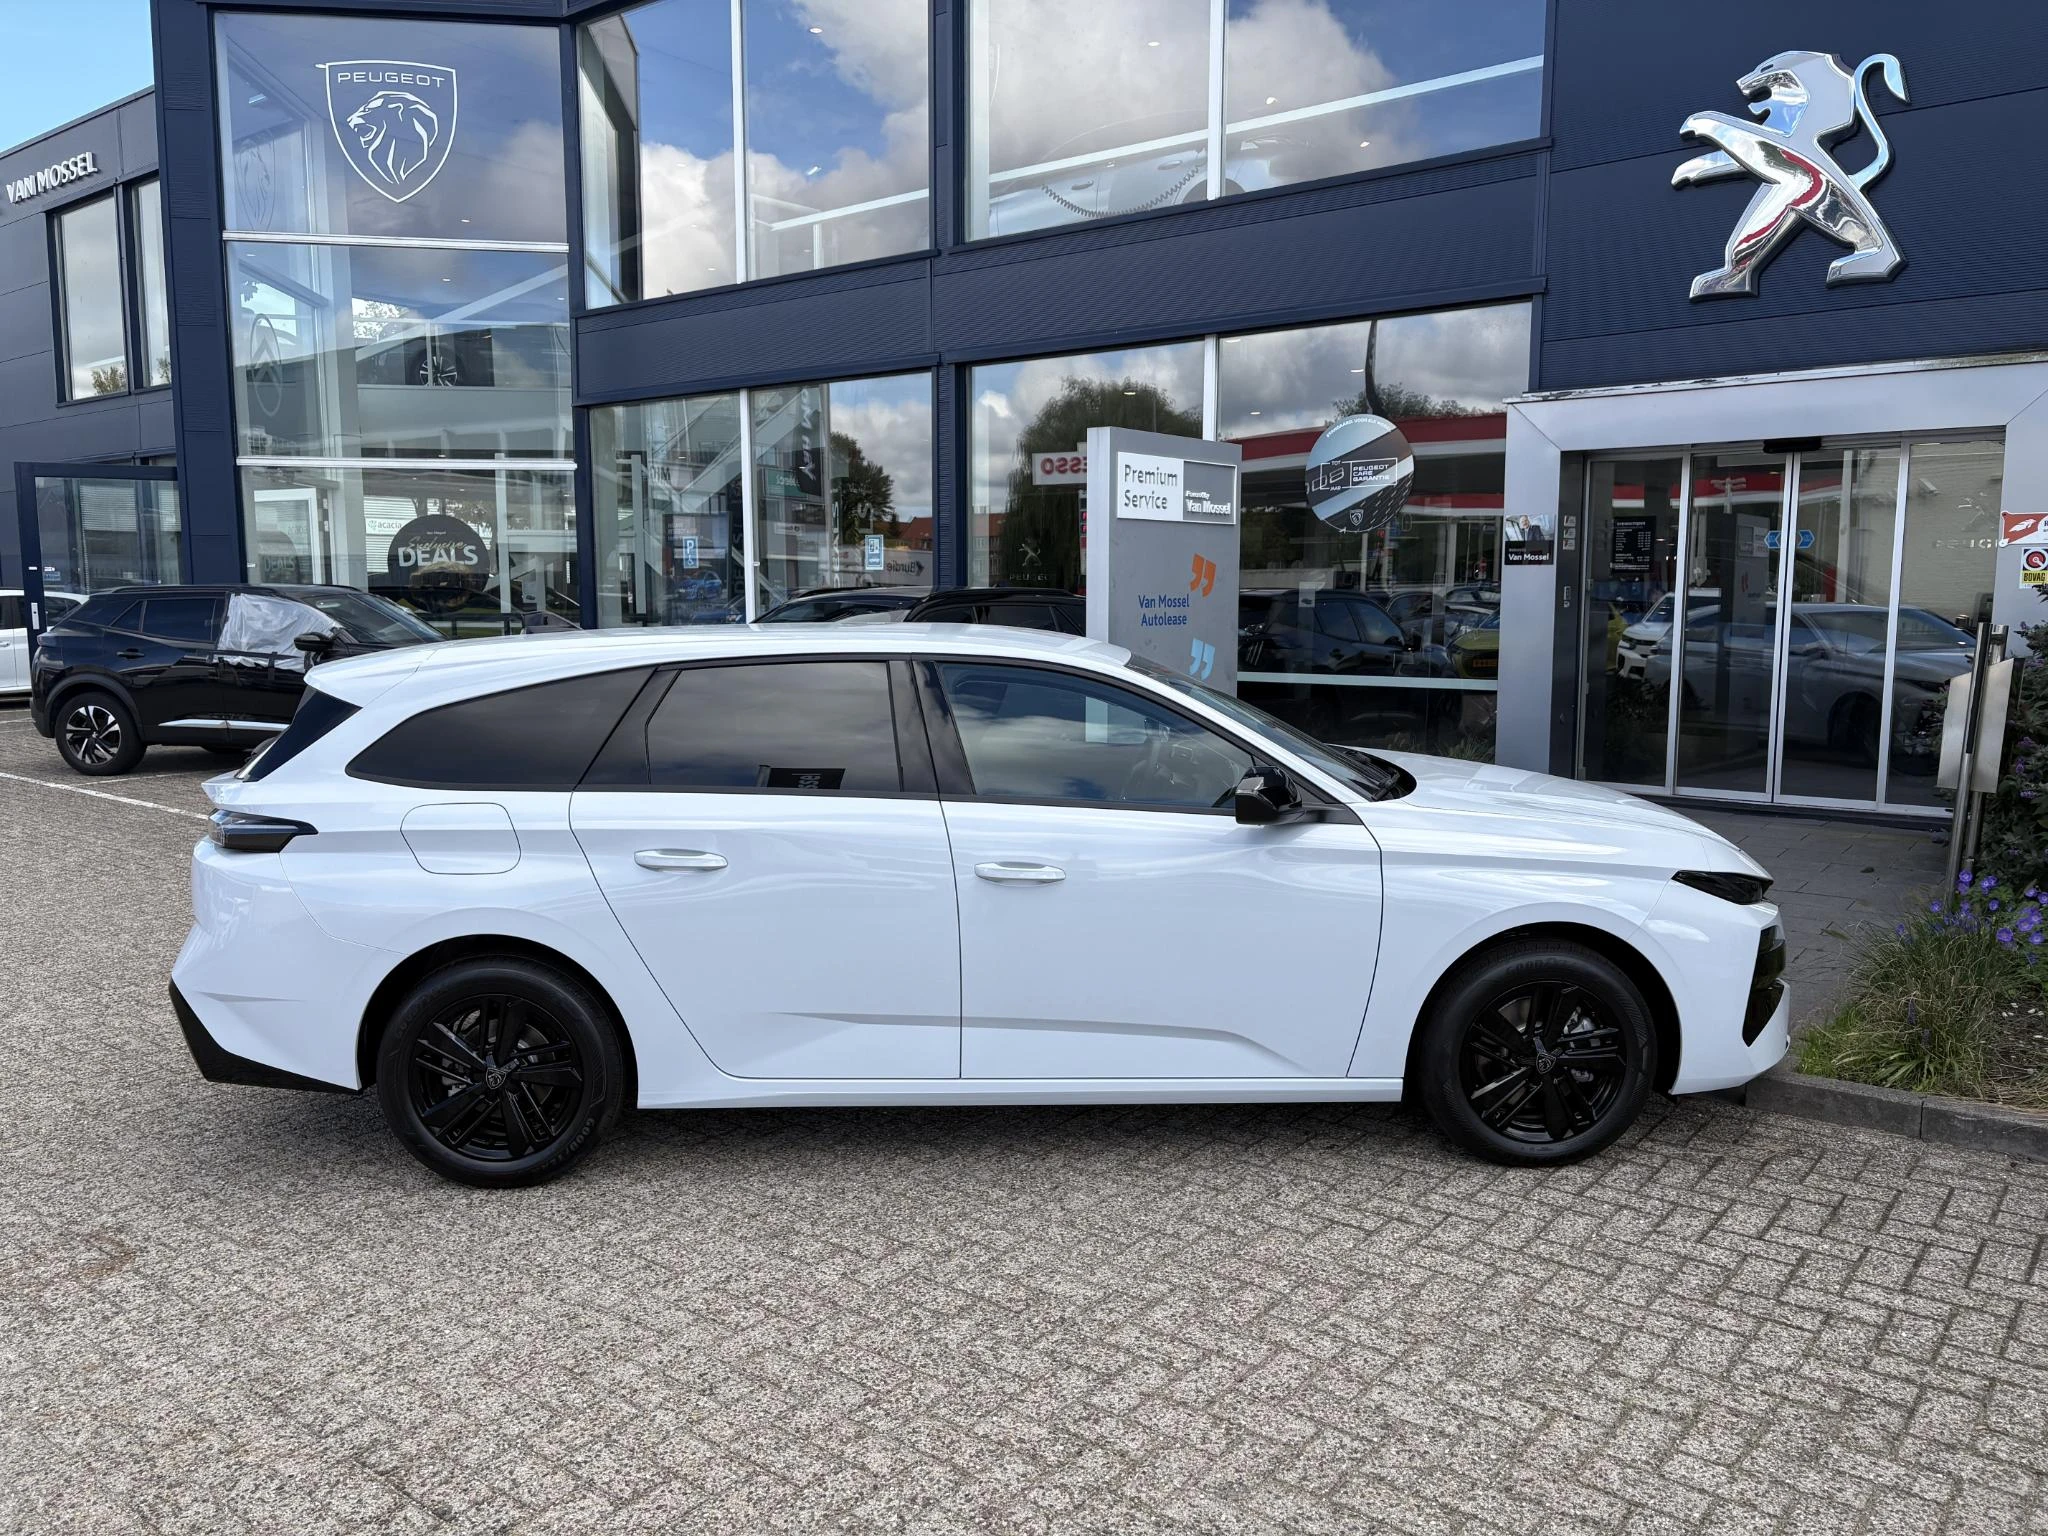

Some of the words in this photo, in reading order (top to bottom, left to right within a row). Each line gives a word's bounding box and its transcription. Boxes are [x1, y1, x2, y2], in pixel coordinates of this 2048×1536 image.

[337, 71, 445, 88] PEUGEOT
[6, 174, 37, 204] VAN
[36, 151, 98, 193] MOSSEL
[1124, 464, 1178, 486] Premium
[1353, 464, 1389, 472] PEUGEOT
[1124, 489, 1168, 509] Service
[1185, 499, 1202, 513] Van
[1202, 500, 1231, 515] Mossel
[397, 545, 479, 567] DEALS
[1508, 553, 1522, 561] Van
[1523, 552, 1550, 561] Mossel
[2023, 572, 2046, 582] BOVAG
[1138, 594, 1156, 609] Van
[1158, 593, 1190, 608] Mossel
[1140, 612, 1188, 627] Autolease
